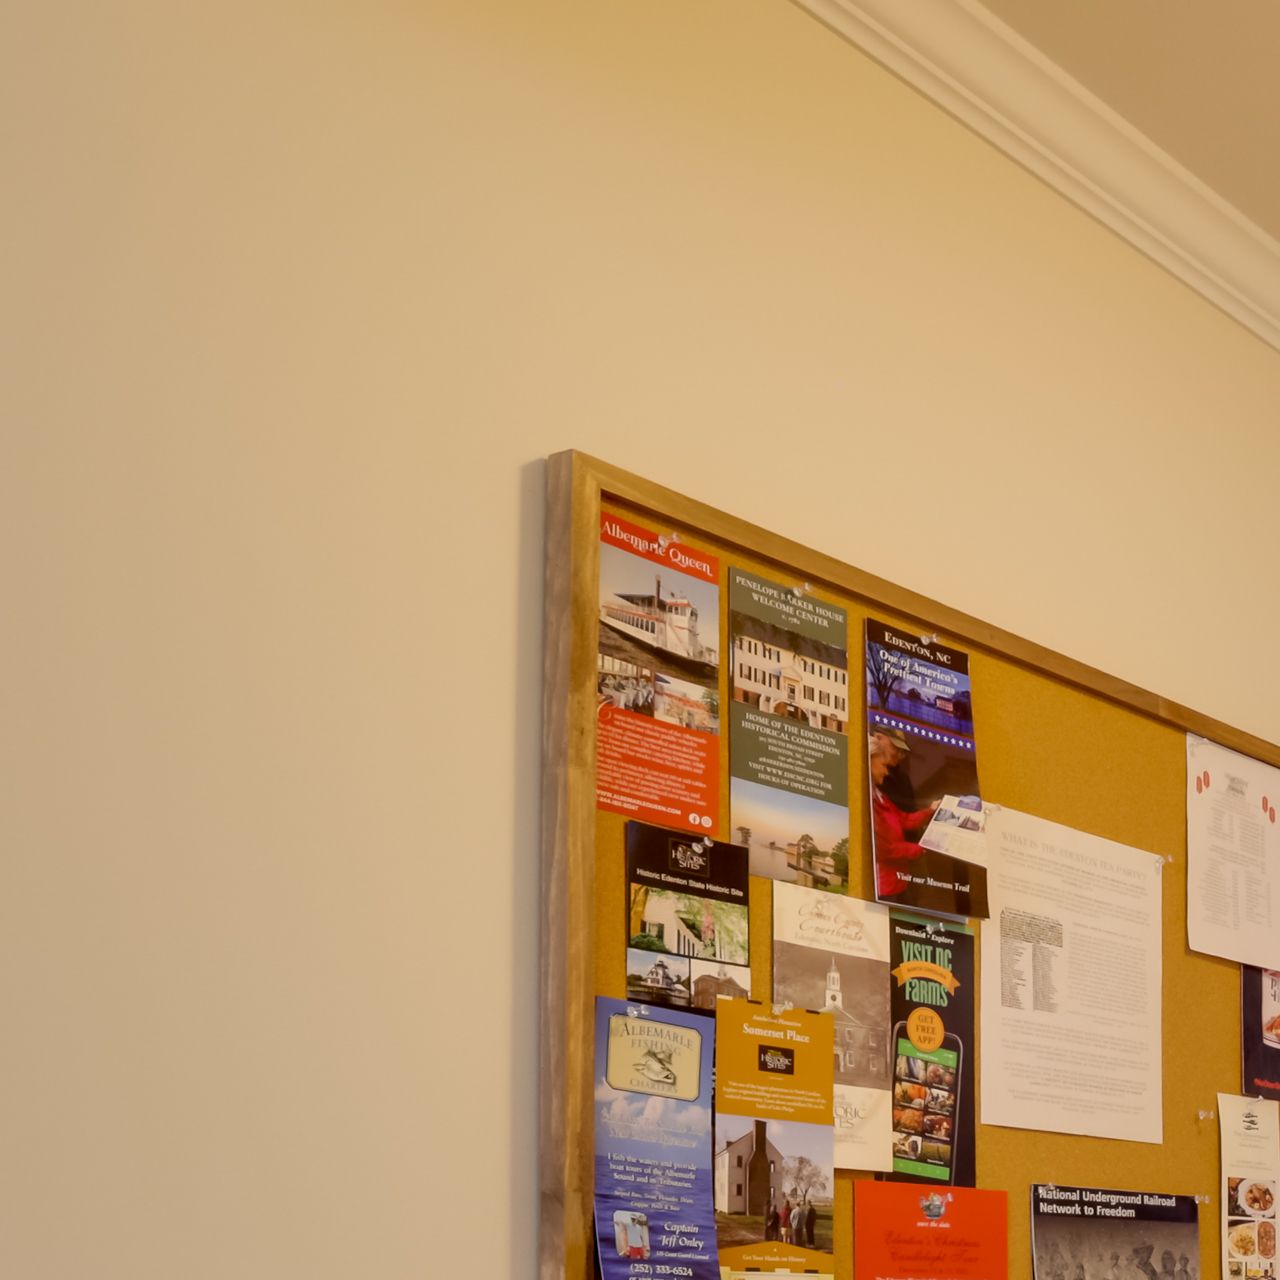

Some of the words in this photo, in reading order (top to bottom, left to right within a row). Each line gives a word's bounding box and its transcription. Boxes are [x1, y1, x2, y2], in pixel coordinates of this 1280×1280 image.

[601, 521, 666, 556] Albemarle
[669, 548, 713, 577] Queen
[735, 575, 779, 599] PENELOPE
[816, 606, 844, 623] HOUSE
[752, 592, 794, 615] WELCOME
[796, 608, 829, 628] CENTER
[879, 649, 899, 664] One
[900, 658, 911, 671] of
[912, 662, 958, 684] America's
[936, 651, 951, 664] NC
[884, 663, 922, 685] Prettiest
[925, 677, 956, 695] Towns
[741, 720, 790, 741] HISTORICAL
[791, 735, 840, 756] COMMISSION
[745, 712, 770, 727] HOME
[771, 720, 782, 729] OF
[784, 723, 799, 734] THE
[800, 728, 836, 745] EDENTON
[636, 868, 660, 880] Historic
[661, 873, 688, 886] Edenton
[688, 879, 706, 890] State
[706, 883, 730, 895] Historic
[731, 887, 744, 897] Site
[896, 871, 912, 882] Visit
[926, 877, 954, 890] Museum
[954, 883, 970, 893] Trail
[931, 934, 955, 945] Explore
[901, 940, 933, 963] VISIT
[915, 1024, 937, 1035] FREE
[917, 1014, 935, 1024] GET
[620, 1022, 694, 1049] ALBEMARLE
[742, 1023, 784, 1040] Somerset
[786, 1029, 811, 1043] Place
[631, 1039, 682, 1057] FISHING
[1039, 1187, 1080, 1201] National
[1082, 1190, 1142, 1206] Underground
[1143, 1195, 1177, 1207] Railroad
[1039, 1202, 1082, 1215] Network
[1084, 1204, 1094, 1215] to
[1096, 1205, 1136, 1218] Freedom
[664, 1221, 699, 1235] Captain
[678, 1236, 704, 1251] Onley
[630, 1263, 653, 1275] (252)
